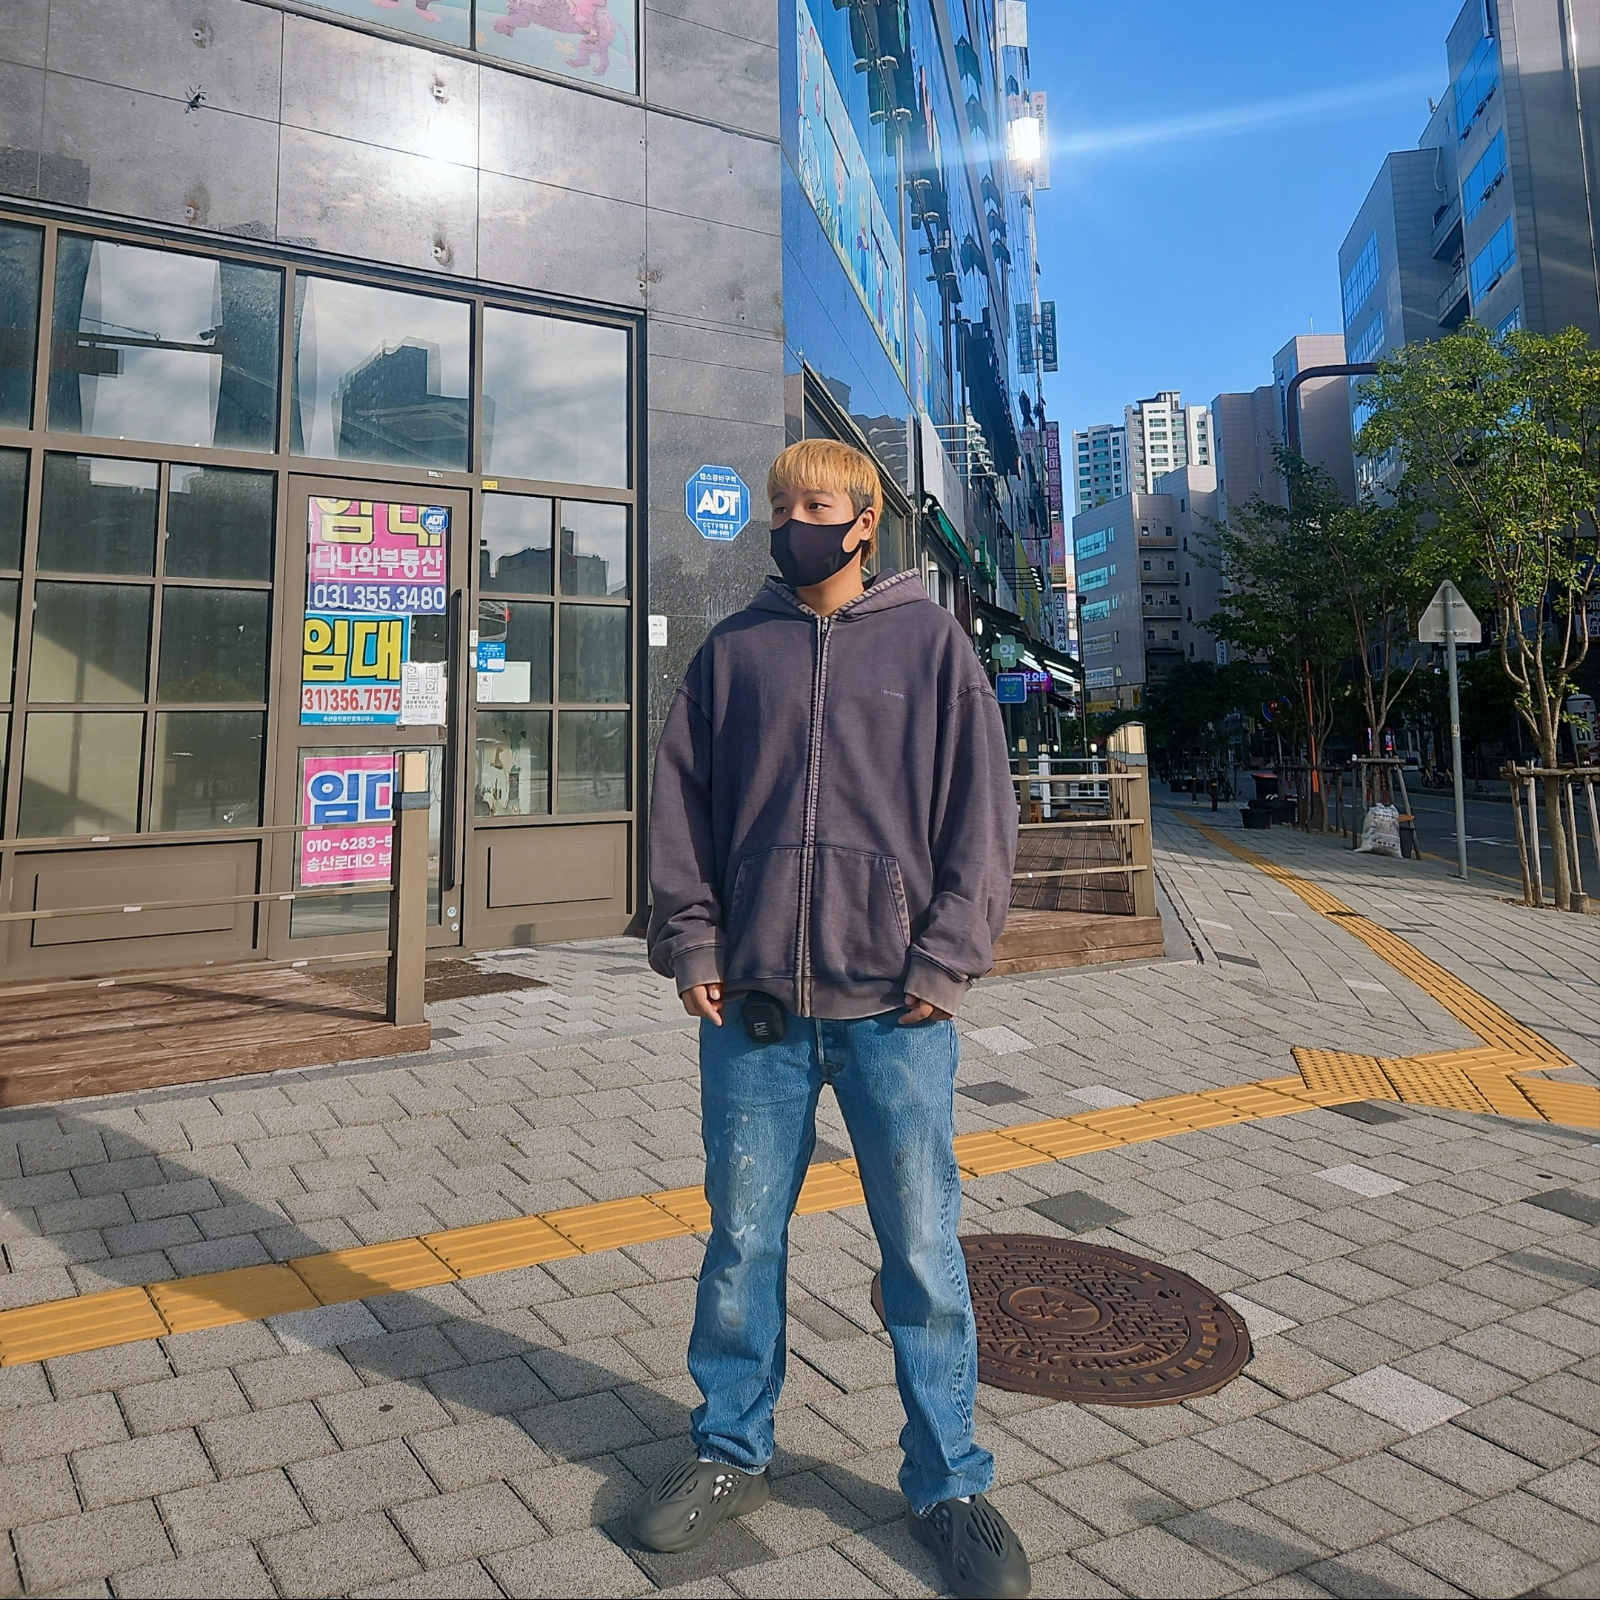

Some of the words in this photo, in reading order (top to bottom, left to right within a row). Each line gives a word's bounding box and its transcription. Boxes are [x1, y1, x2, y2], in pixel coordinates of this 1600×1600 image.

[1047, 438, 1060, 469] 아로마
[697, 488, 740, 517] ADT
[426, 515, 445, 526] ADT
[315, 545, 443, 579] 다나와부동산
[314, 584, 446, 611] 031.355.3480
[1055, 593, 1067, 651] 시그니처독서실
[303, 617, 403, 682] 임대
[999, 644, 1016, 662] 약
[306, 854, 376, 873] 송산로데오
